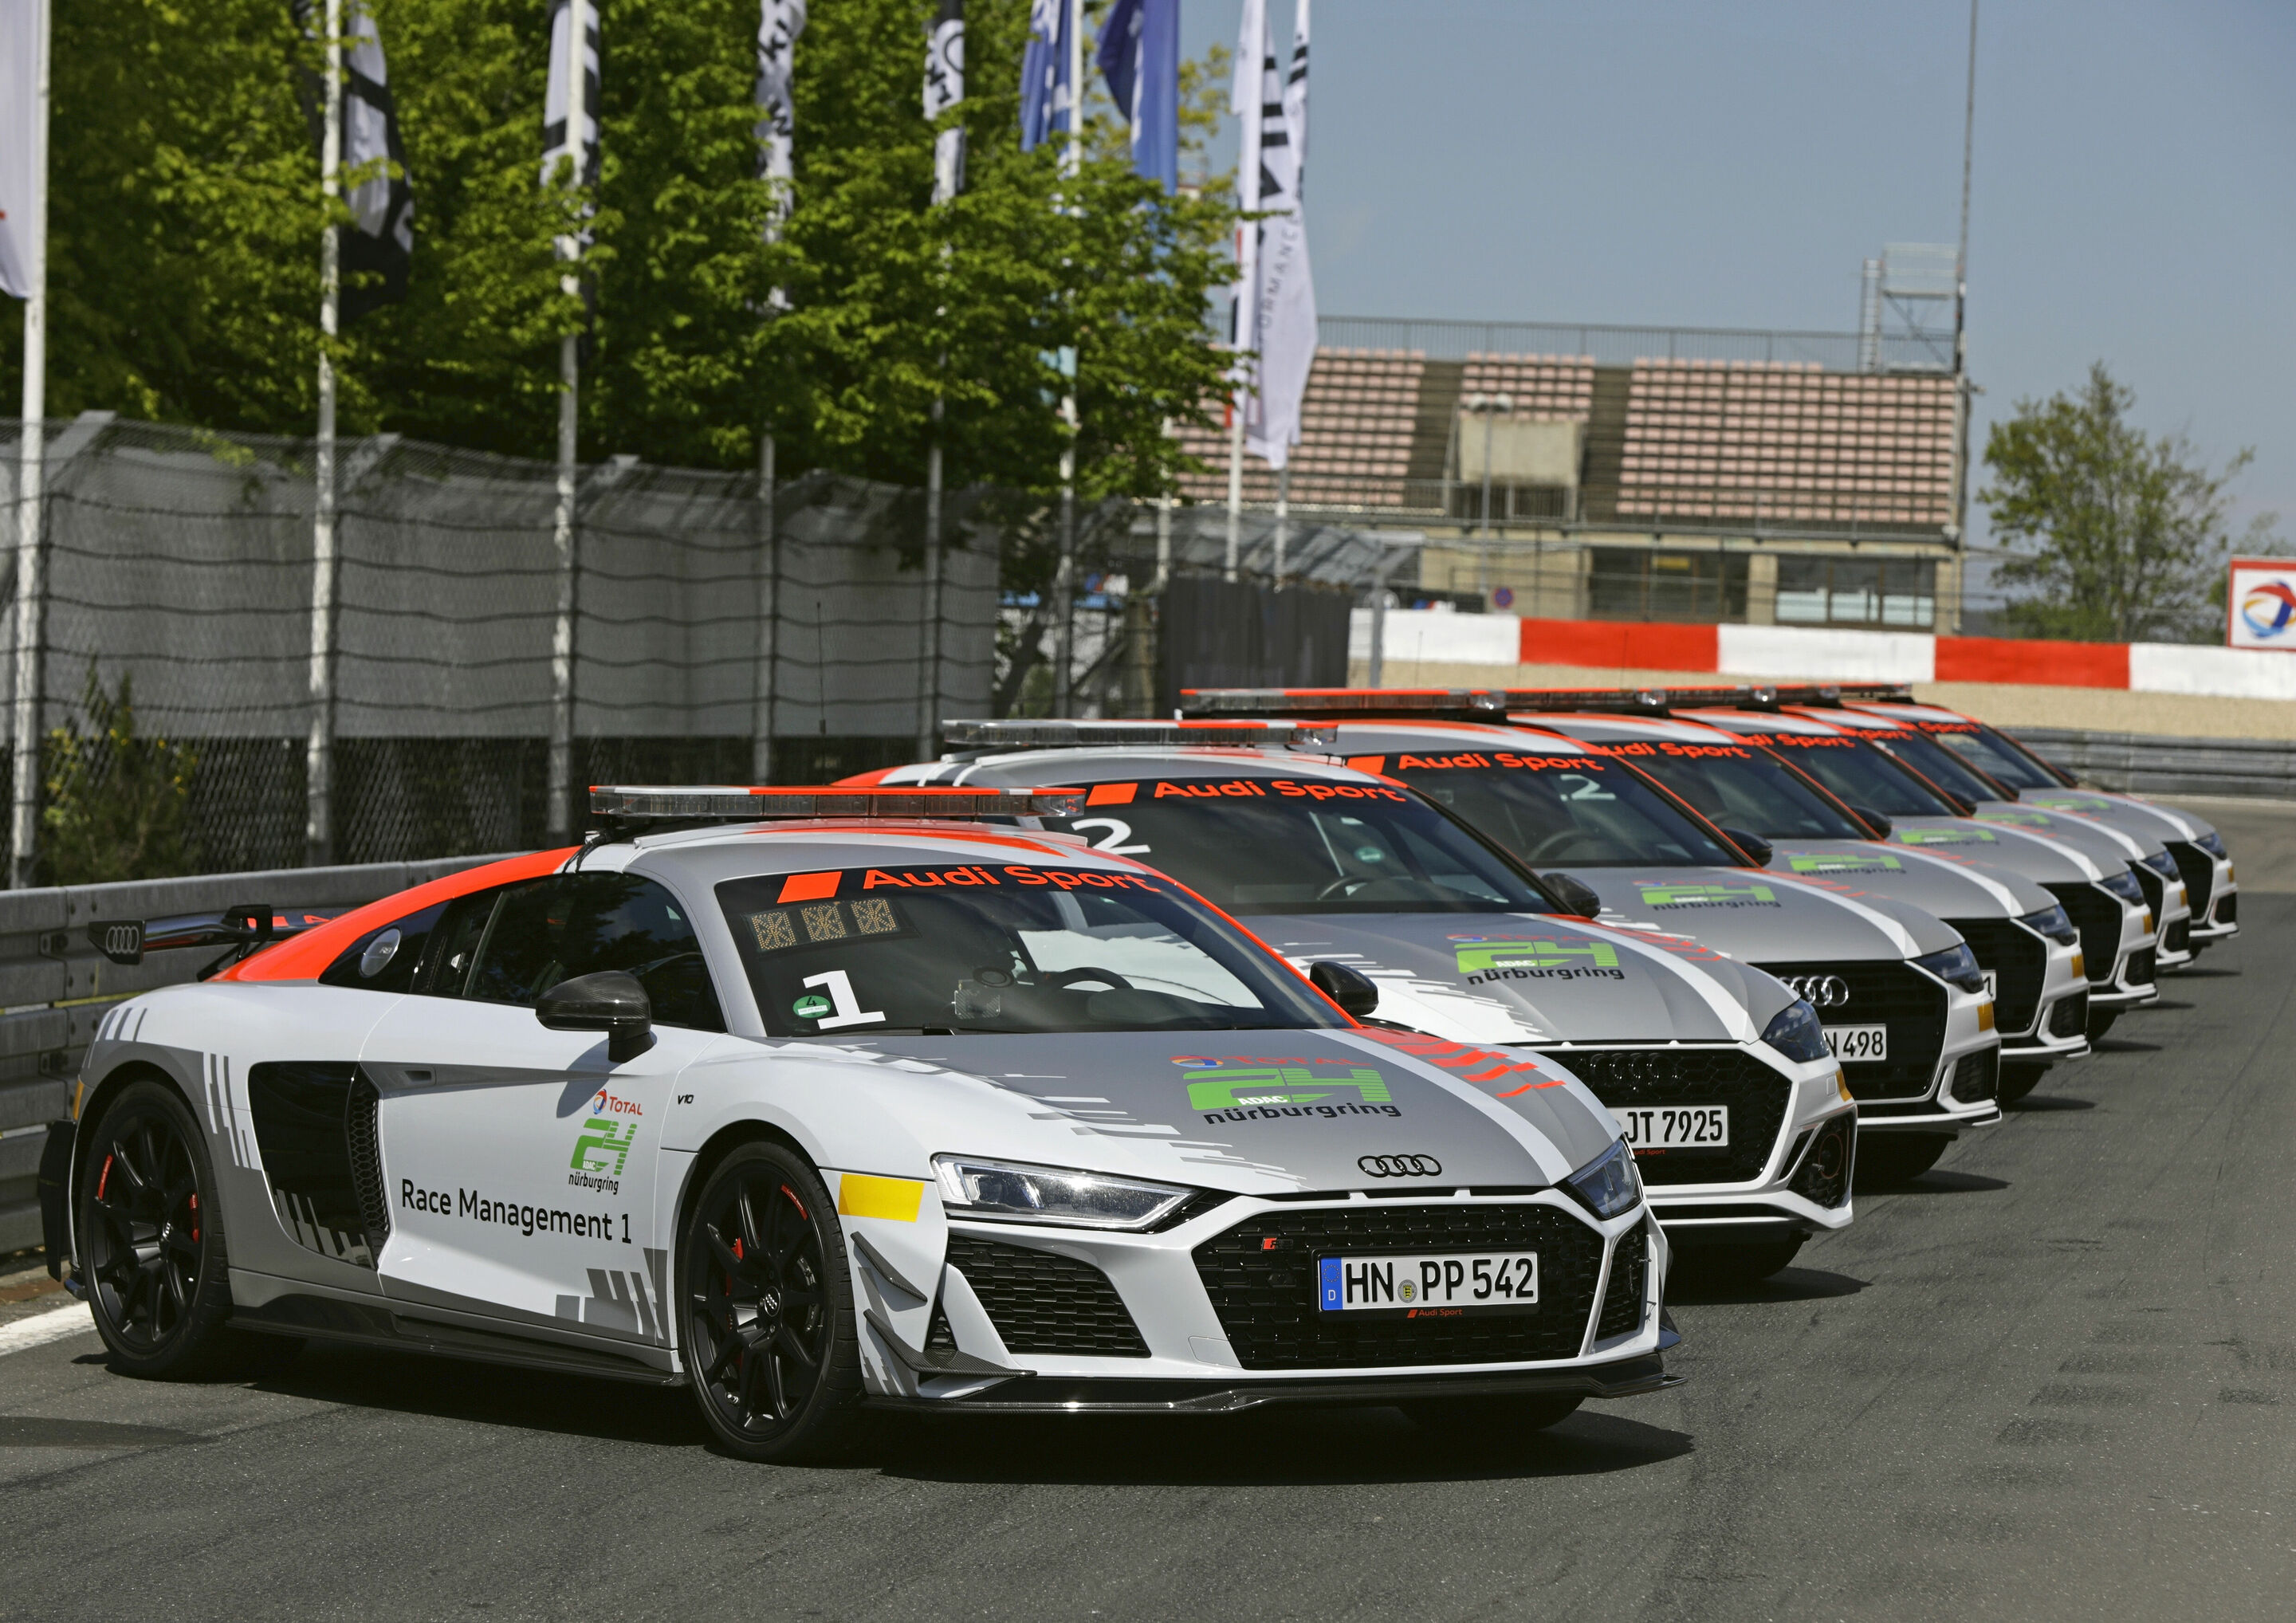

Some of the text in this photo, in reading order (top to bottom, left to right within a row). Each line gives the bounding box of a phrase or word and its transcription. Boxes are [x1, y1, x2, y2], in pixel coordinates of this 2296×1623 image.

[1658, 742, 1752, 758] Sport
[1775, 733, 1856, 749] Sport
[1398, 753, 1605, 771] Audi Sport
[1154, 780, 1407, 803] Audi Sport
[1071, 817, 1151, 855] 2
[863, 865, 1162, 893] Audi Sport
[1467, 966, 1626, 985] nürburgring
[802, 969, 887, 1030] 1
[806, 996, 818, 1007] 4
[1842, 1031, 1884, 1057] 498
[1222, 1055, 1373, 1067] TOTAL
[1237, 1094, 1288, 1106] ADAC
[1202, 1102, 1402, 1125] nürburgring
[1624, 1110, 1723, 1143] JT 7925
[582, 1160, 596, 1172] ADAC
[568, 1172, 619, 1196] nürburgring
[401, 1178, 632, 1244] Race Management 1
[1345, 1258, 1534, 1303] HN PP 542
[1327, 1289, 1337, 1302] D
[1418, 1307, 1463, 1317] Audi Sport
